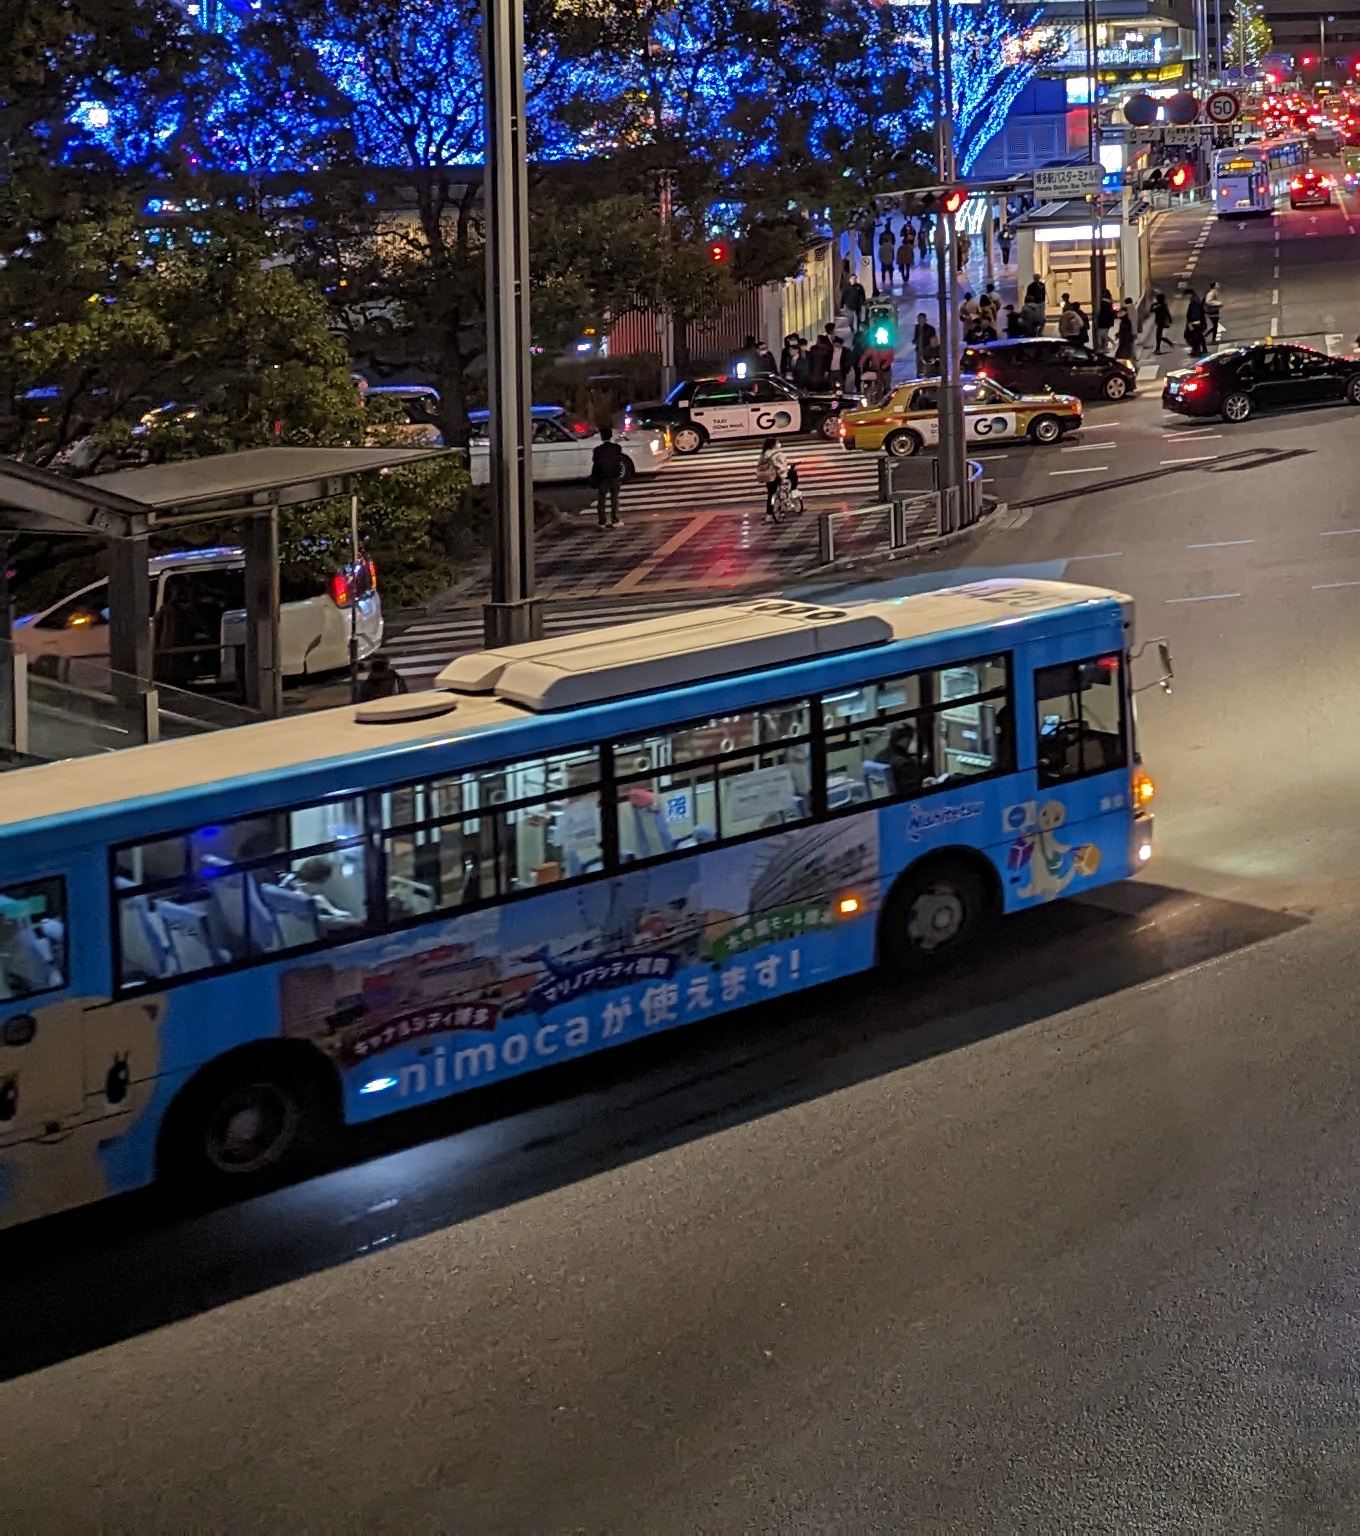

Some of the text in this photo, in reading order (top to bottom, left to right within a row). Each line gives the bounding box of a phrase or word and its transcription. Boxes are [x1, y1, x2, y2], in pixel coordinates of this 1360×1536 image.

[1213, 100, 1232, 115] 50
[756, 411, 791, 430] GO
[973, 416, 1008, 436] GO
